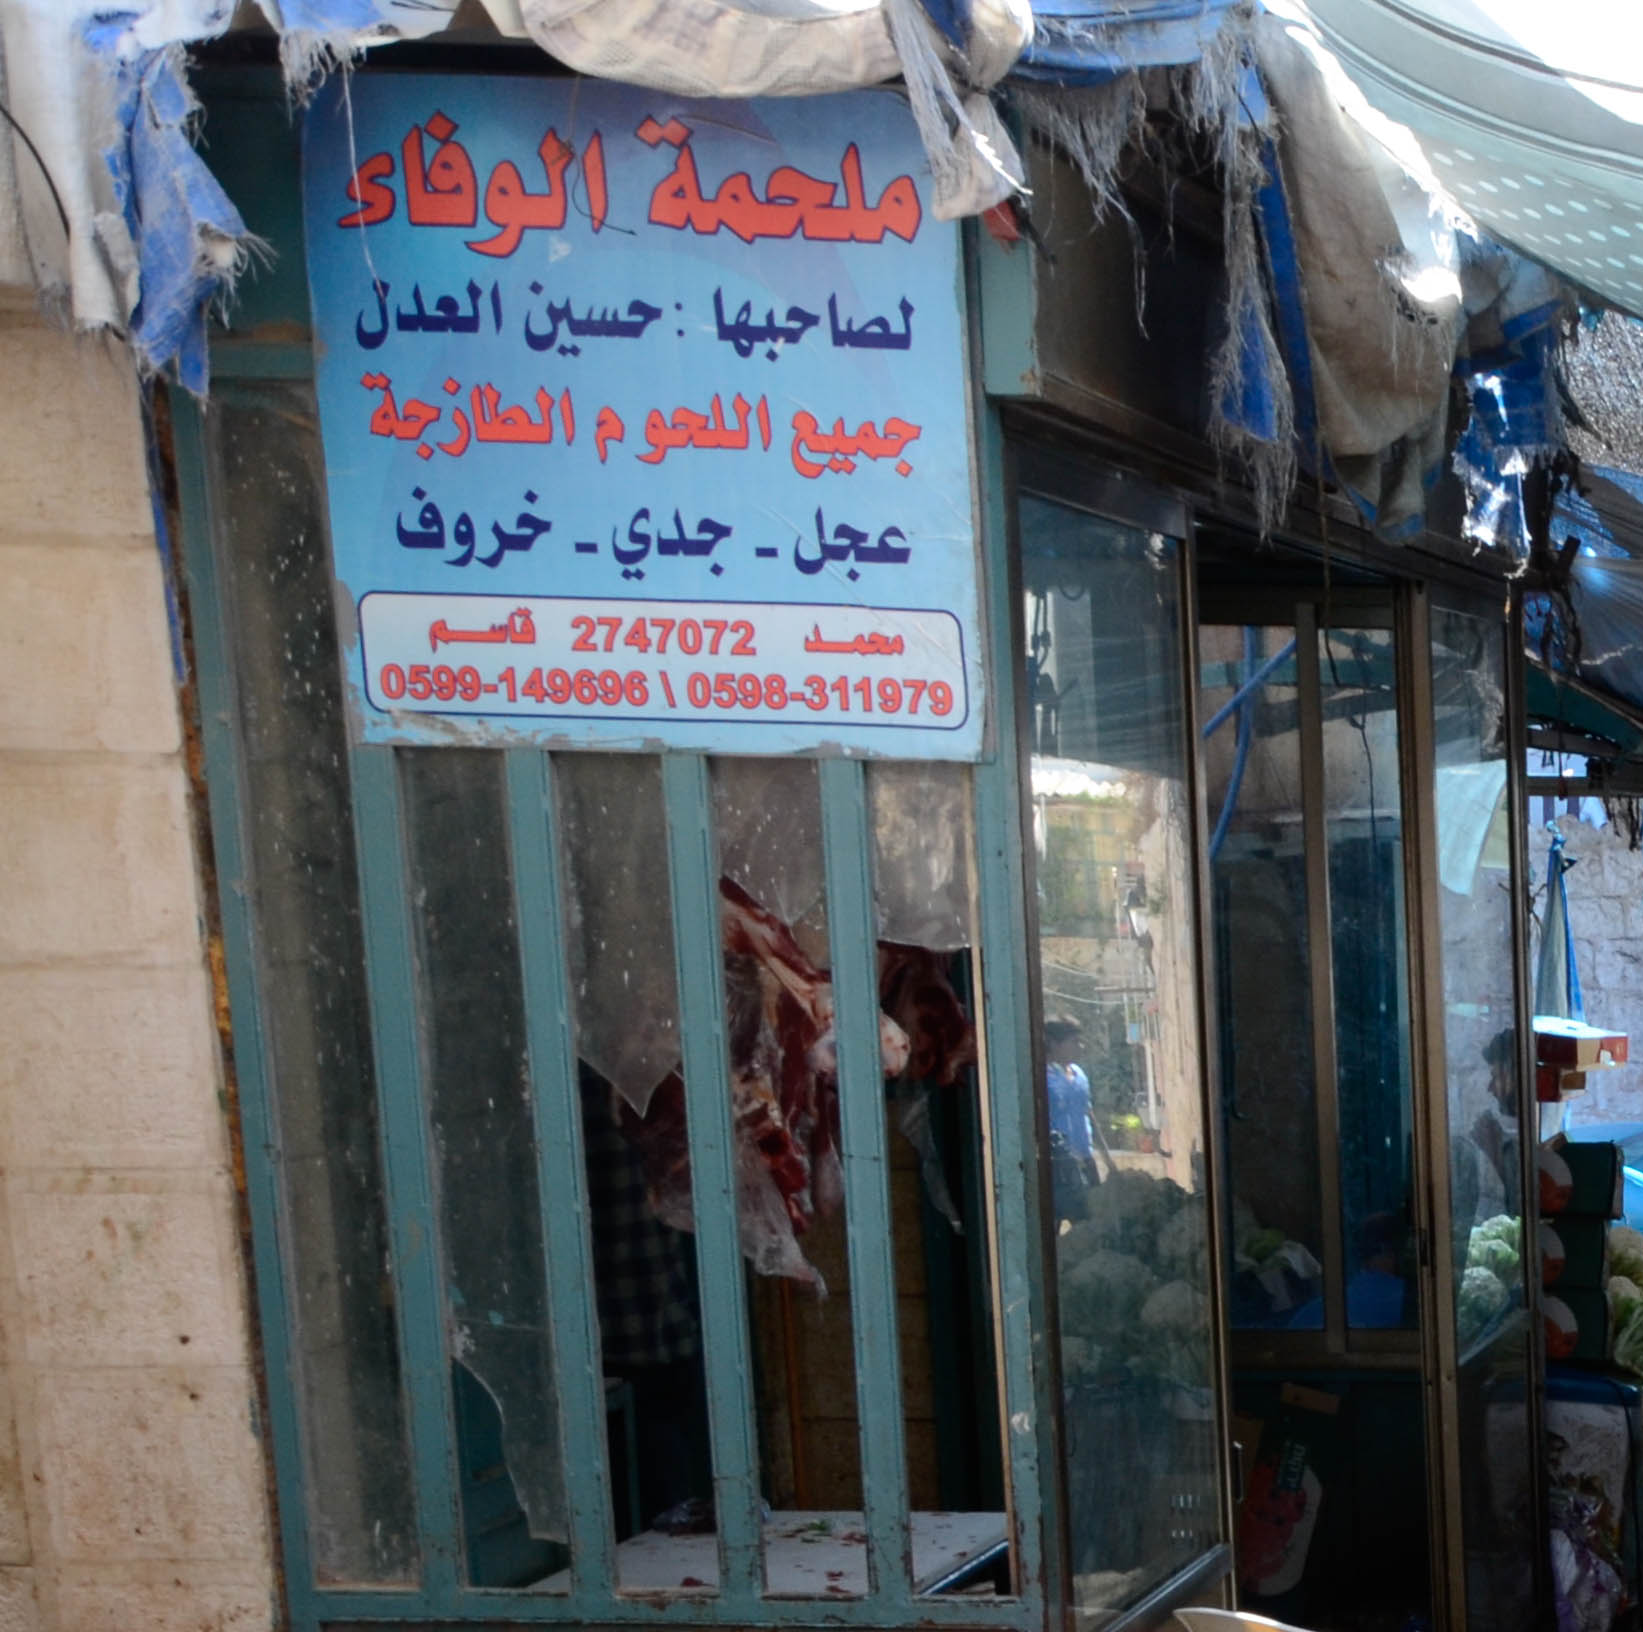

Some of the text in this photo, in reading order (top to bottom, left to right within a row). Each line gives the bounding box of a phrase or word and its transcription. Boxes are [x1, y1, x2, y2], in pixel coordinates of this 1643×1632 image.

[337, 109, 923, 259] ملحمة الوفاء
[355, 278, 503, 351] العدل
[523, 280, 663, 358] حسين
[712, 285, 915, 362] لصاحبها
[360, 372, 922, 478] جميع اللحوم الطازجة
[394, 486, 554, 568] خروف
[611, 506, 734, 580] جدي
[792, 505, 912, 582] عجل
[570, 614, 757, 657] 2747072
[379, 662, 649, 707] 0599-149696
[686, 675, 954, 717] 0598-311979
